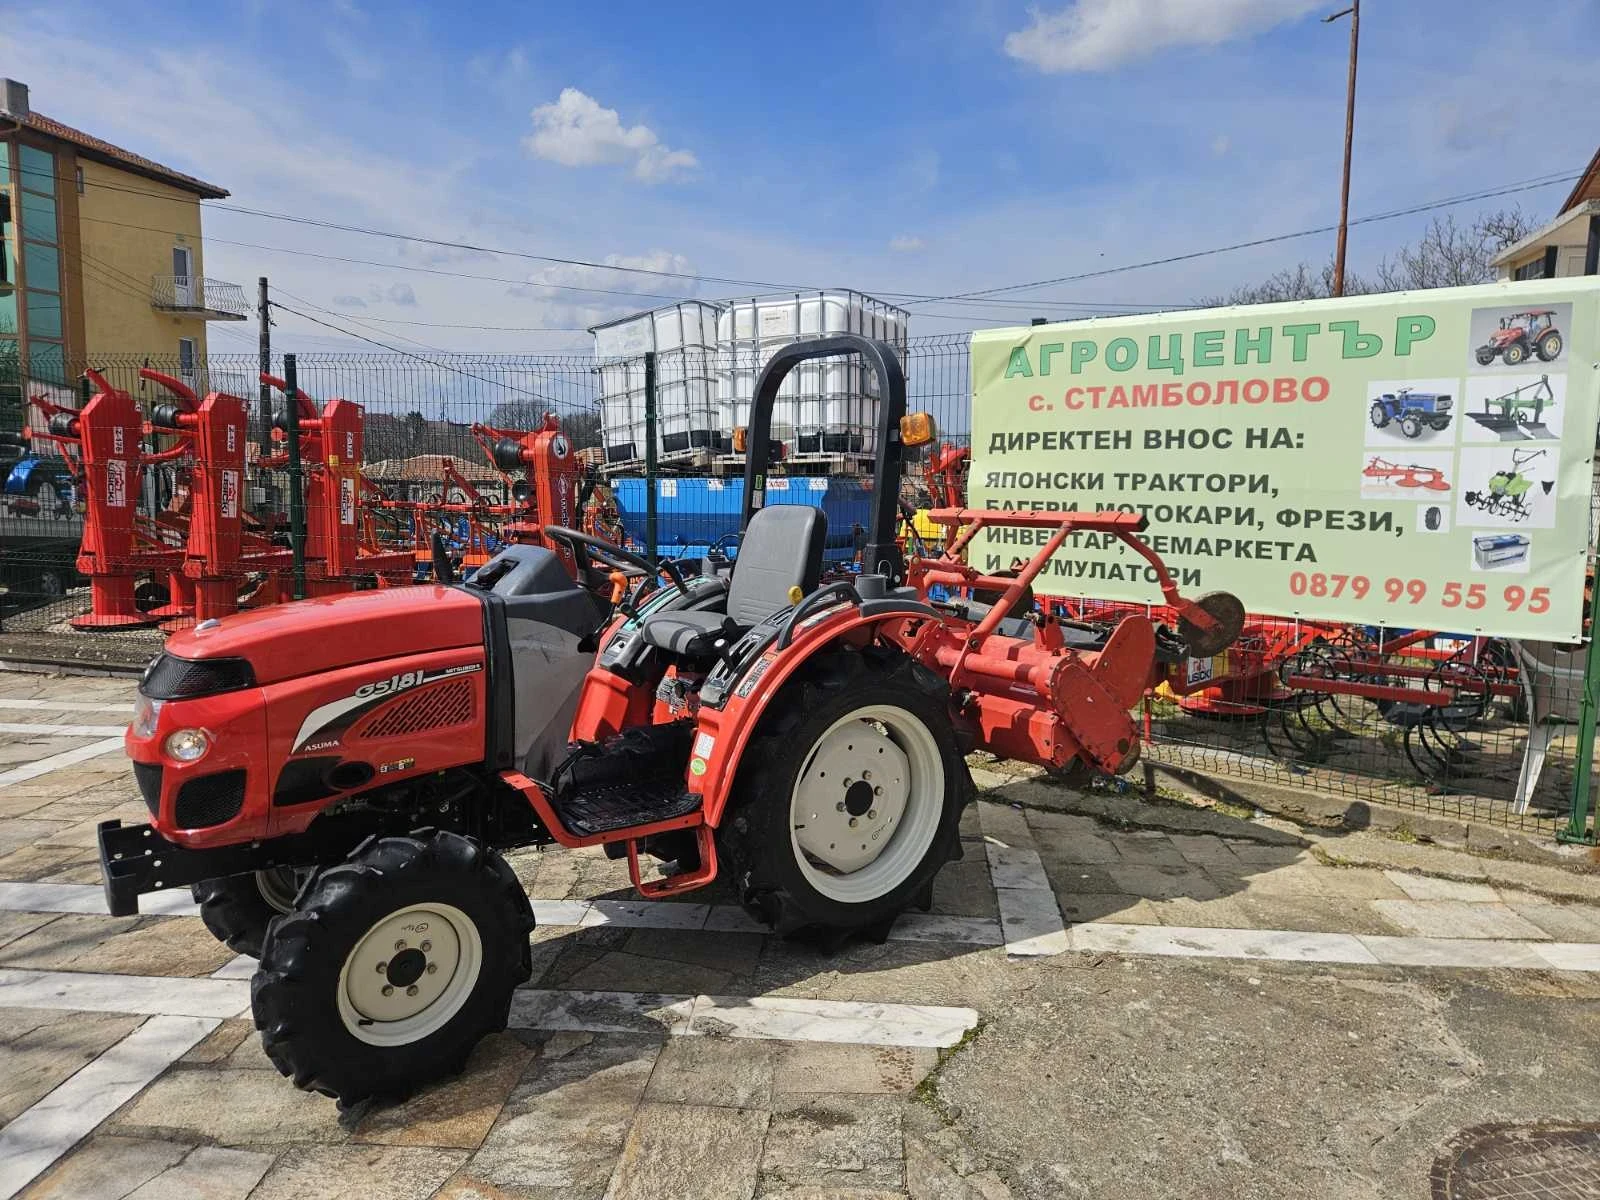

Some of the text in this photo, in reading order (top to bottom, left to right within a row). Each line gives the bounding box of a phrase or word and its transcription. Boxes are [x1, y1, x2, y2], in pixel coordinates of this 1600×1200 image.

[1004, 315, 1436, 378] АГРОЦЕНТЪР
[1028, 376, 1330, 411] с. СТАМБОЛОВО
[989, 427, 1304, 454] ДИРЕКТЕН ВНОС НА:
[985, 472, 1279, 498] ЯПОНСКИ ТРАКТОРИ,
[1276, 508, 1403, 537] ФРЕЗИ,
[986, 554, 1001, 570] И
[1289, 571, 1551, 614] 0879 99 55 95
[355, 670, 424, 698] GS181
[304, 740, 339, 752] ASUMA
